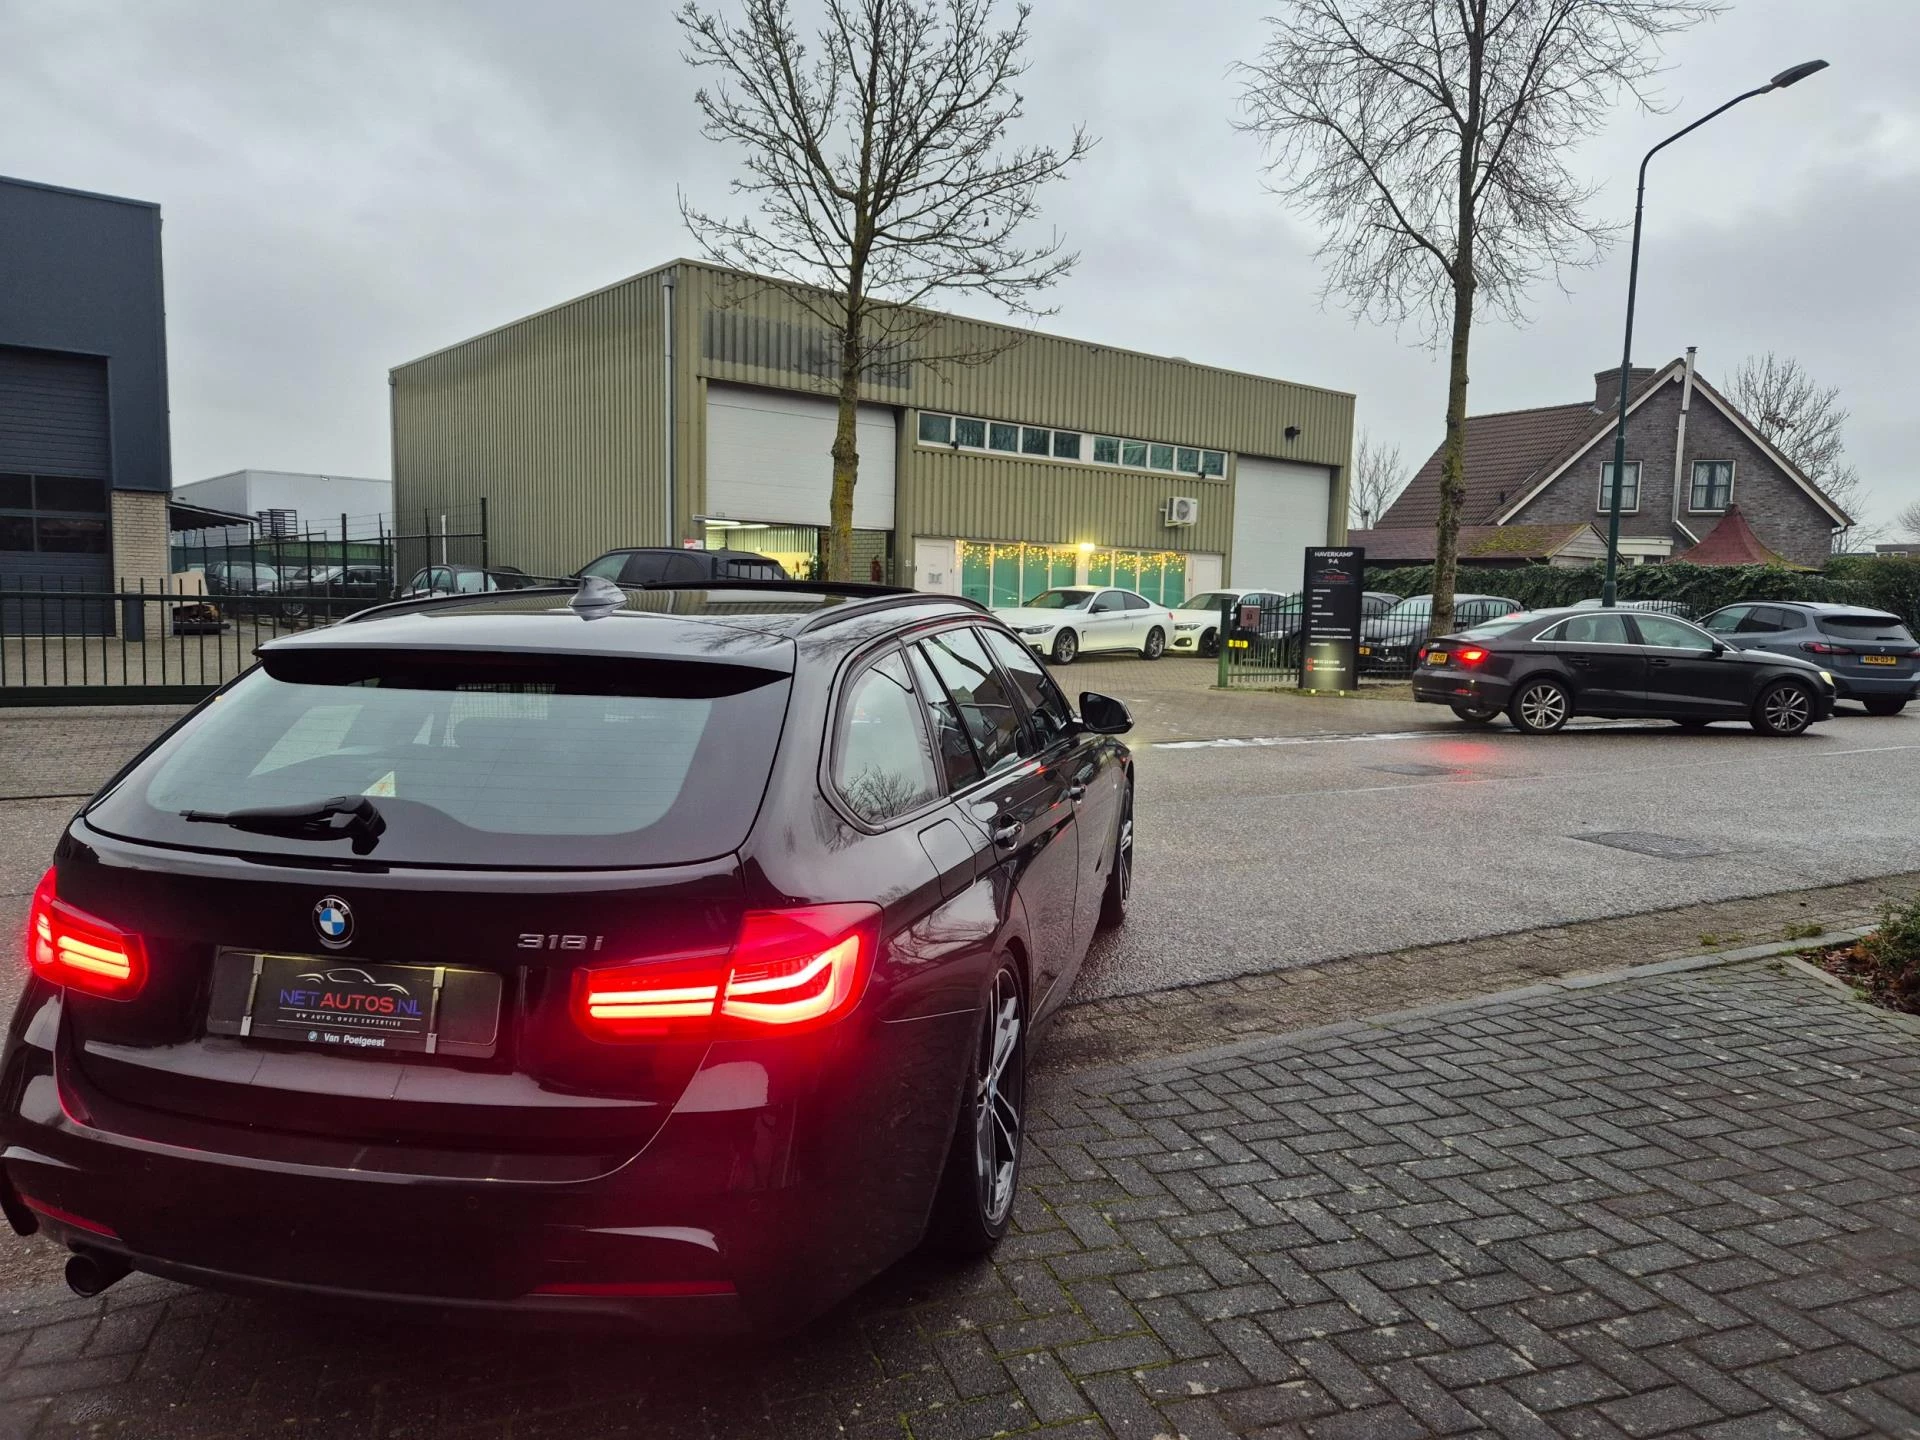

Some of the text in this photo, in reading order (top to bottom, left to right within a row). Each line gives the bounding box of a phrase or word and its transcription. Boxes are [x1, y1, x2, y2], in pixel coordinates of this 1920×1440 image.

[315, 900, 350, 915] BMW
[324, 1033, 386, 1048] Van Poelgeest
